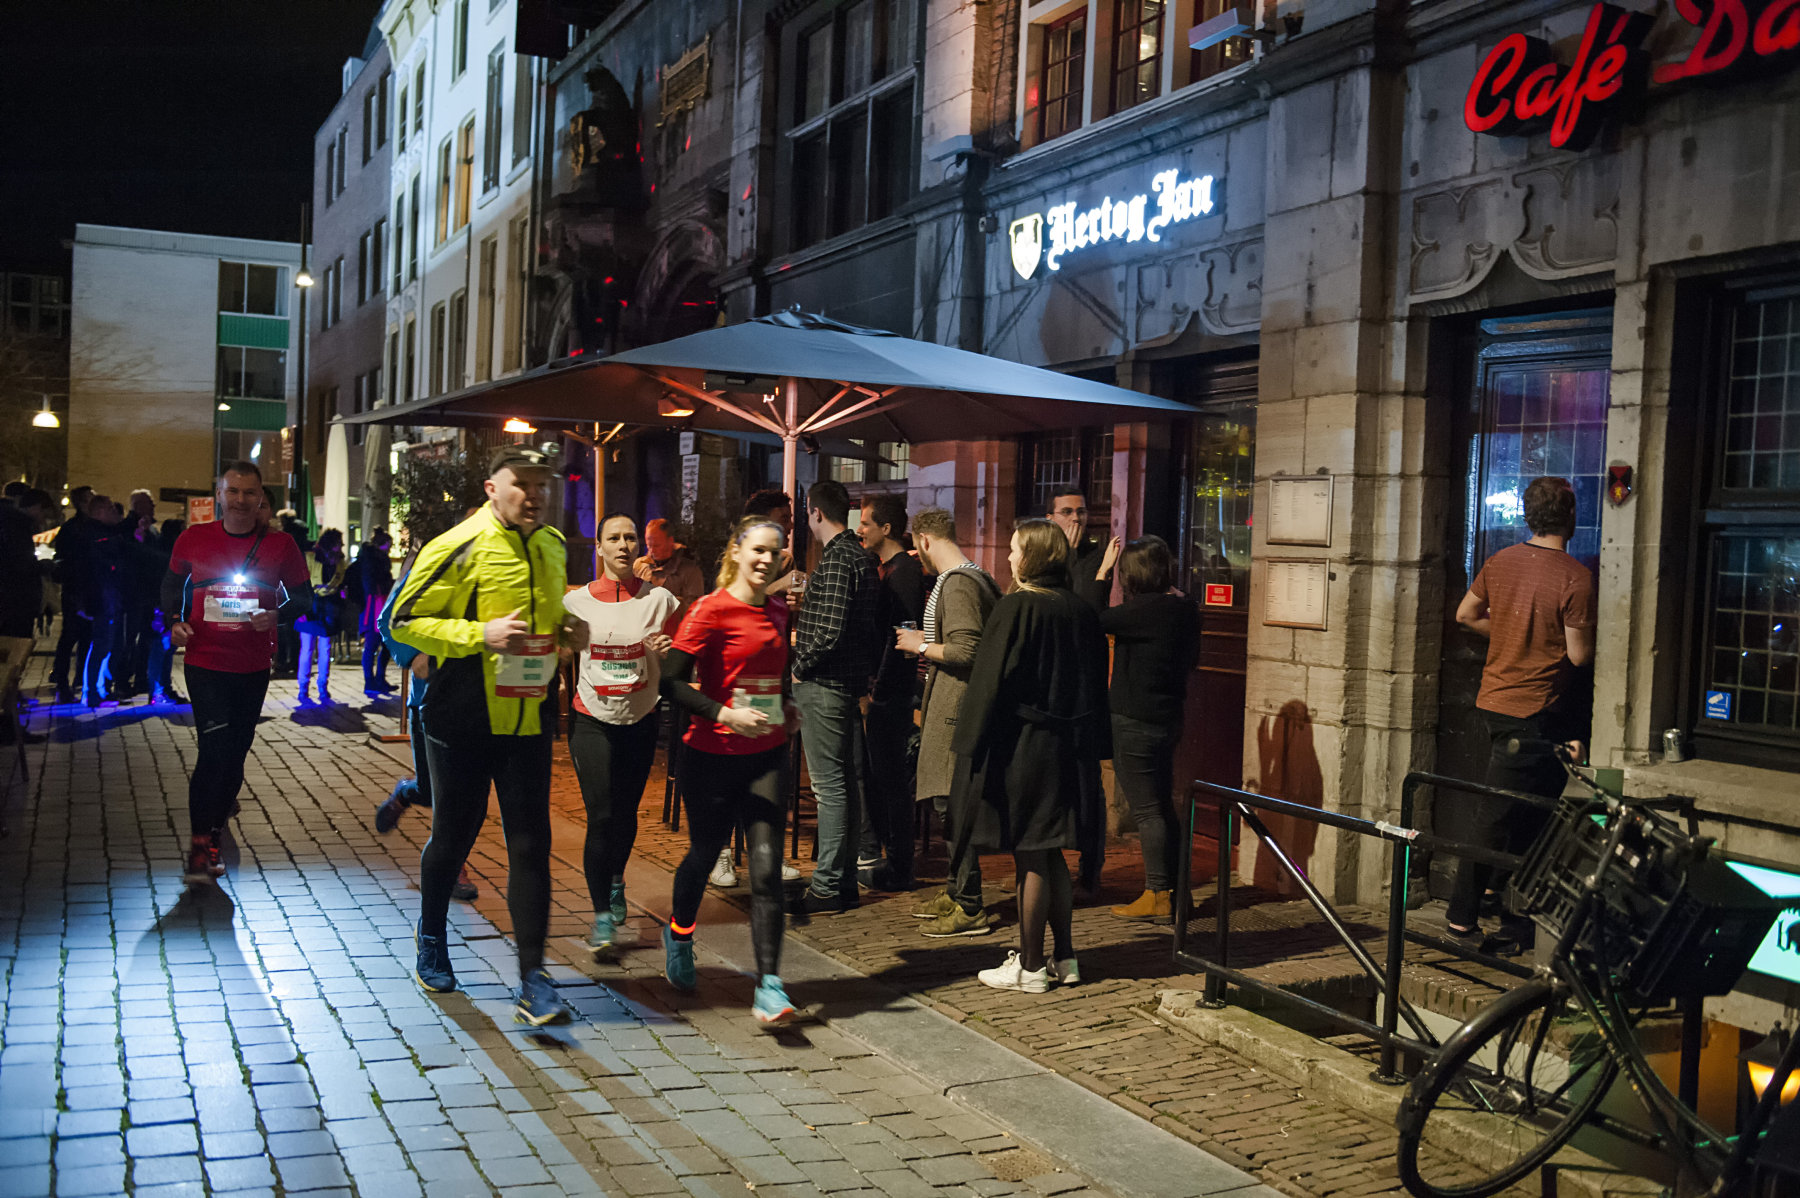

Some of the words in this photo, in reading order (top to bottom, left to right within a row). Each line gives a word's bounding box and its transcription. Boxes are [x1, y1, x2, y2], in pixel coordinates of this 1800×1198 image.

[1464, 3, 1632, 147] Café
[1047, 194, 1148, 270] Hertog
[1147, 168, 1214, 242] Jan
